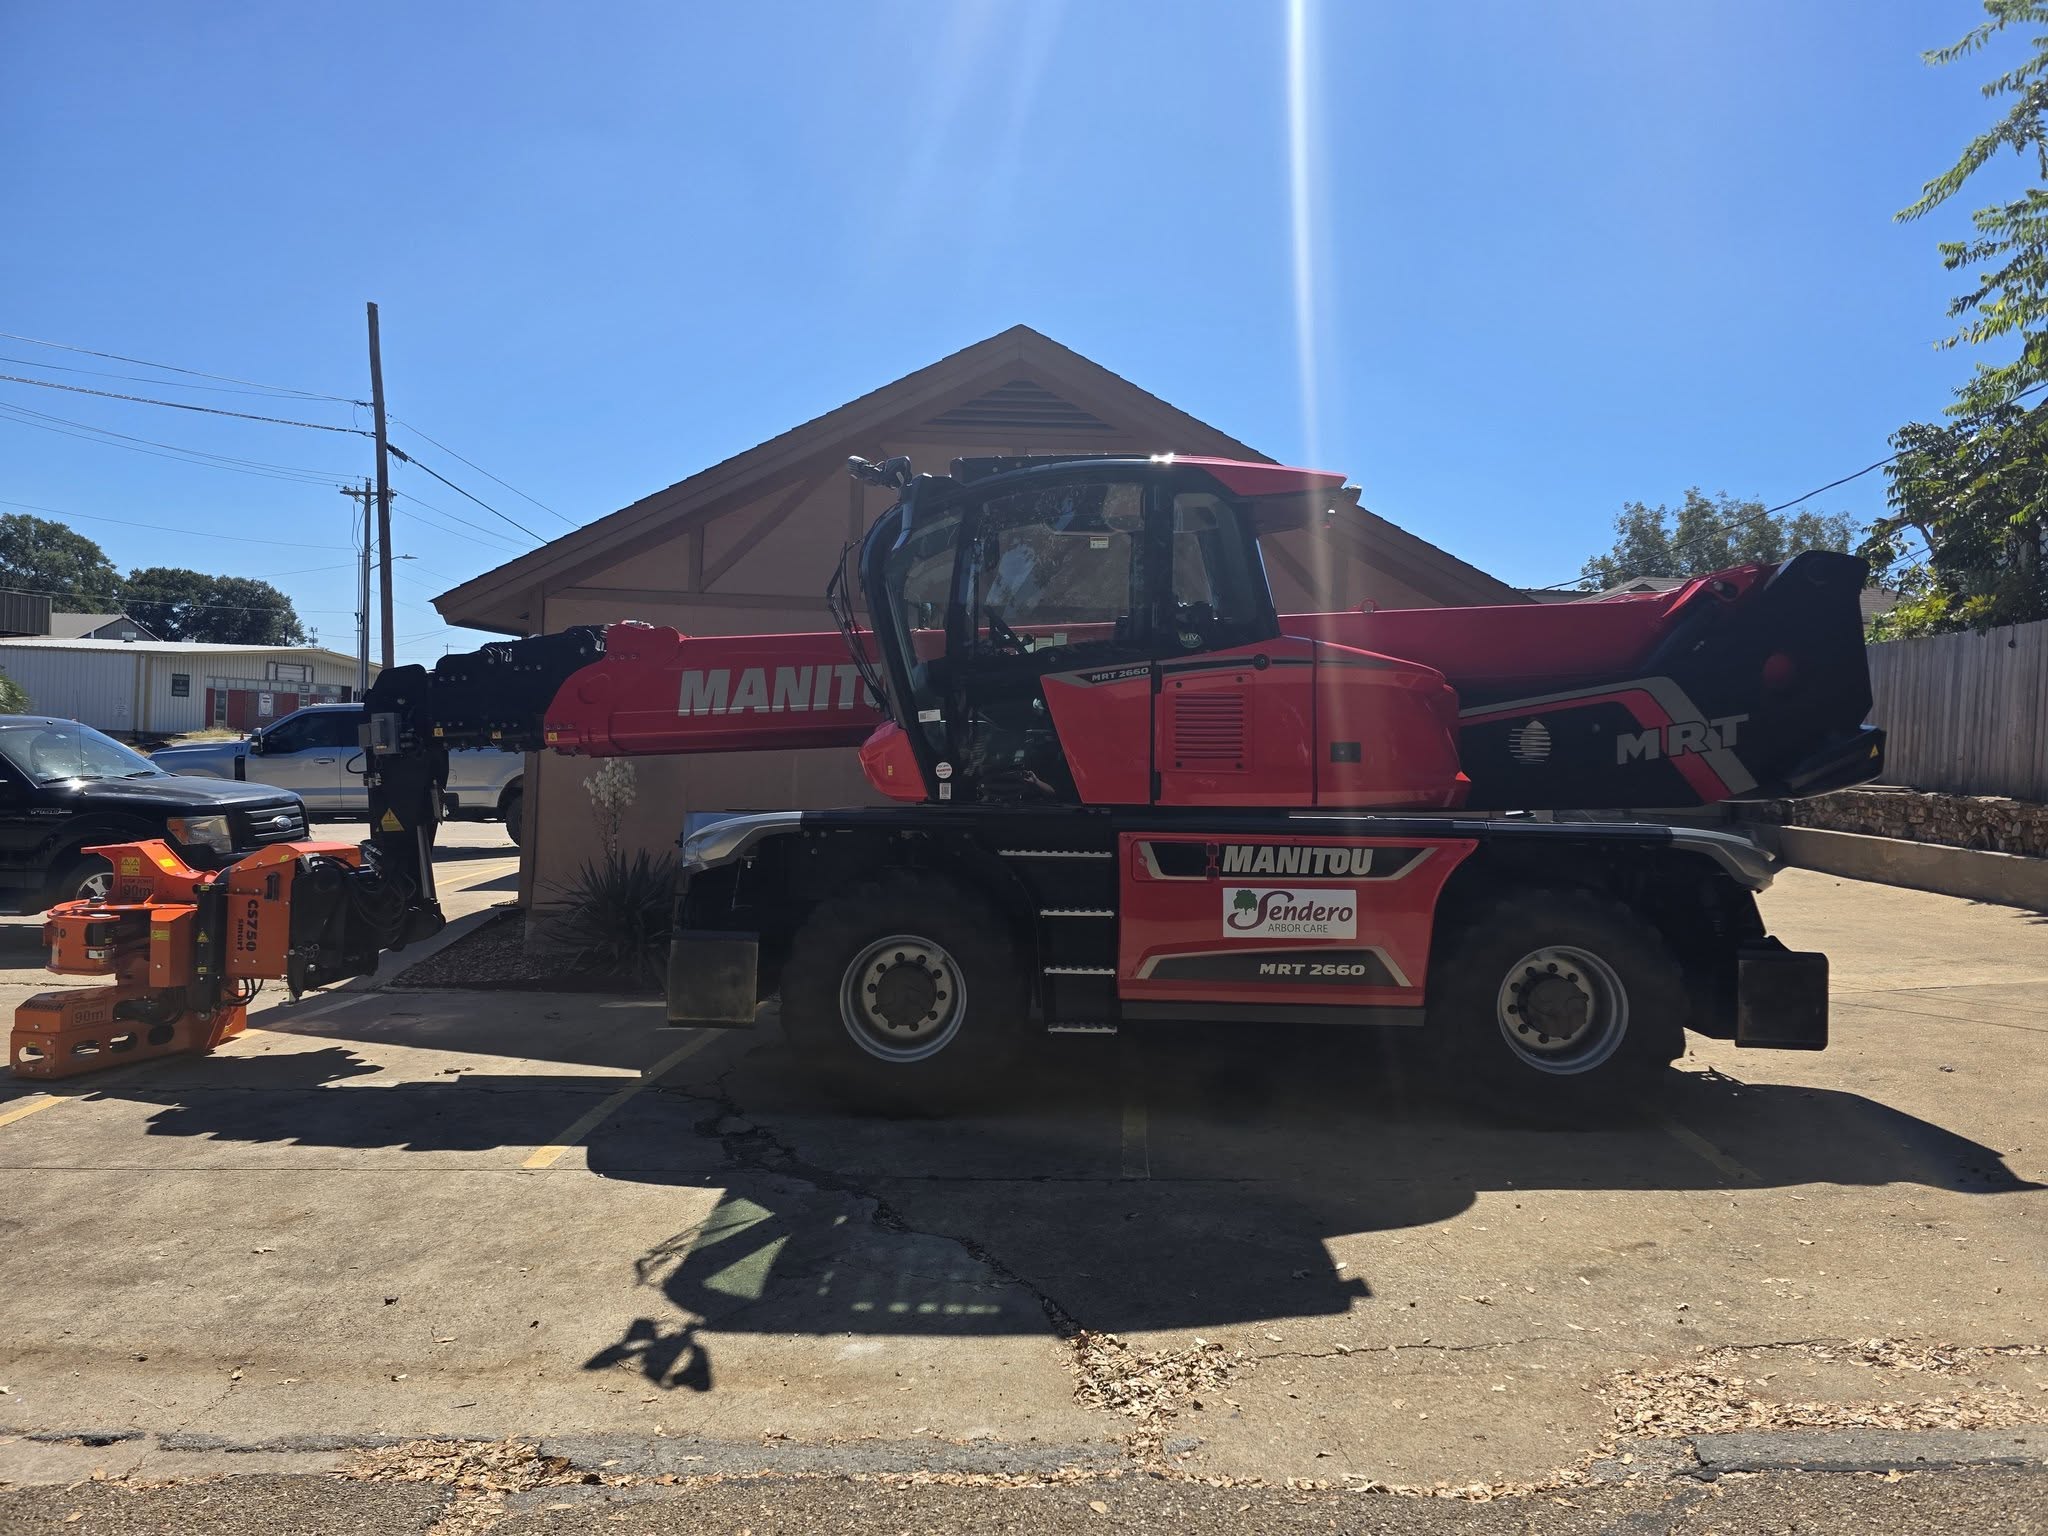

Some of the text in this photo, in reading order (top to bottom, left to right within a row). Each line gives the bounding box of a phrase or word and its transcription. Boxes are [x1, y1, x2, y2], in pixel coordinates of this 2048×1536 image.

[1091, 667, 1149, 681] MRT 2660
[1616, 713, 1750, 765] MRT
[1222, 845, 1374, 875] MANITOU
[1226, 890, 1353, 930] Sendero
[246, 899, 259, 952] CS750
[1267, 923, 1328, 933] ARBOR CARE
[1259, 963, 1366, 976] MRT 2660
